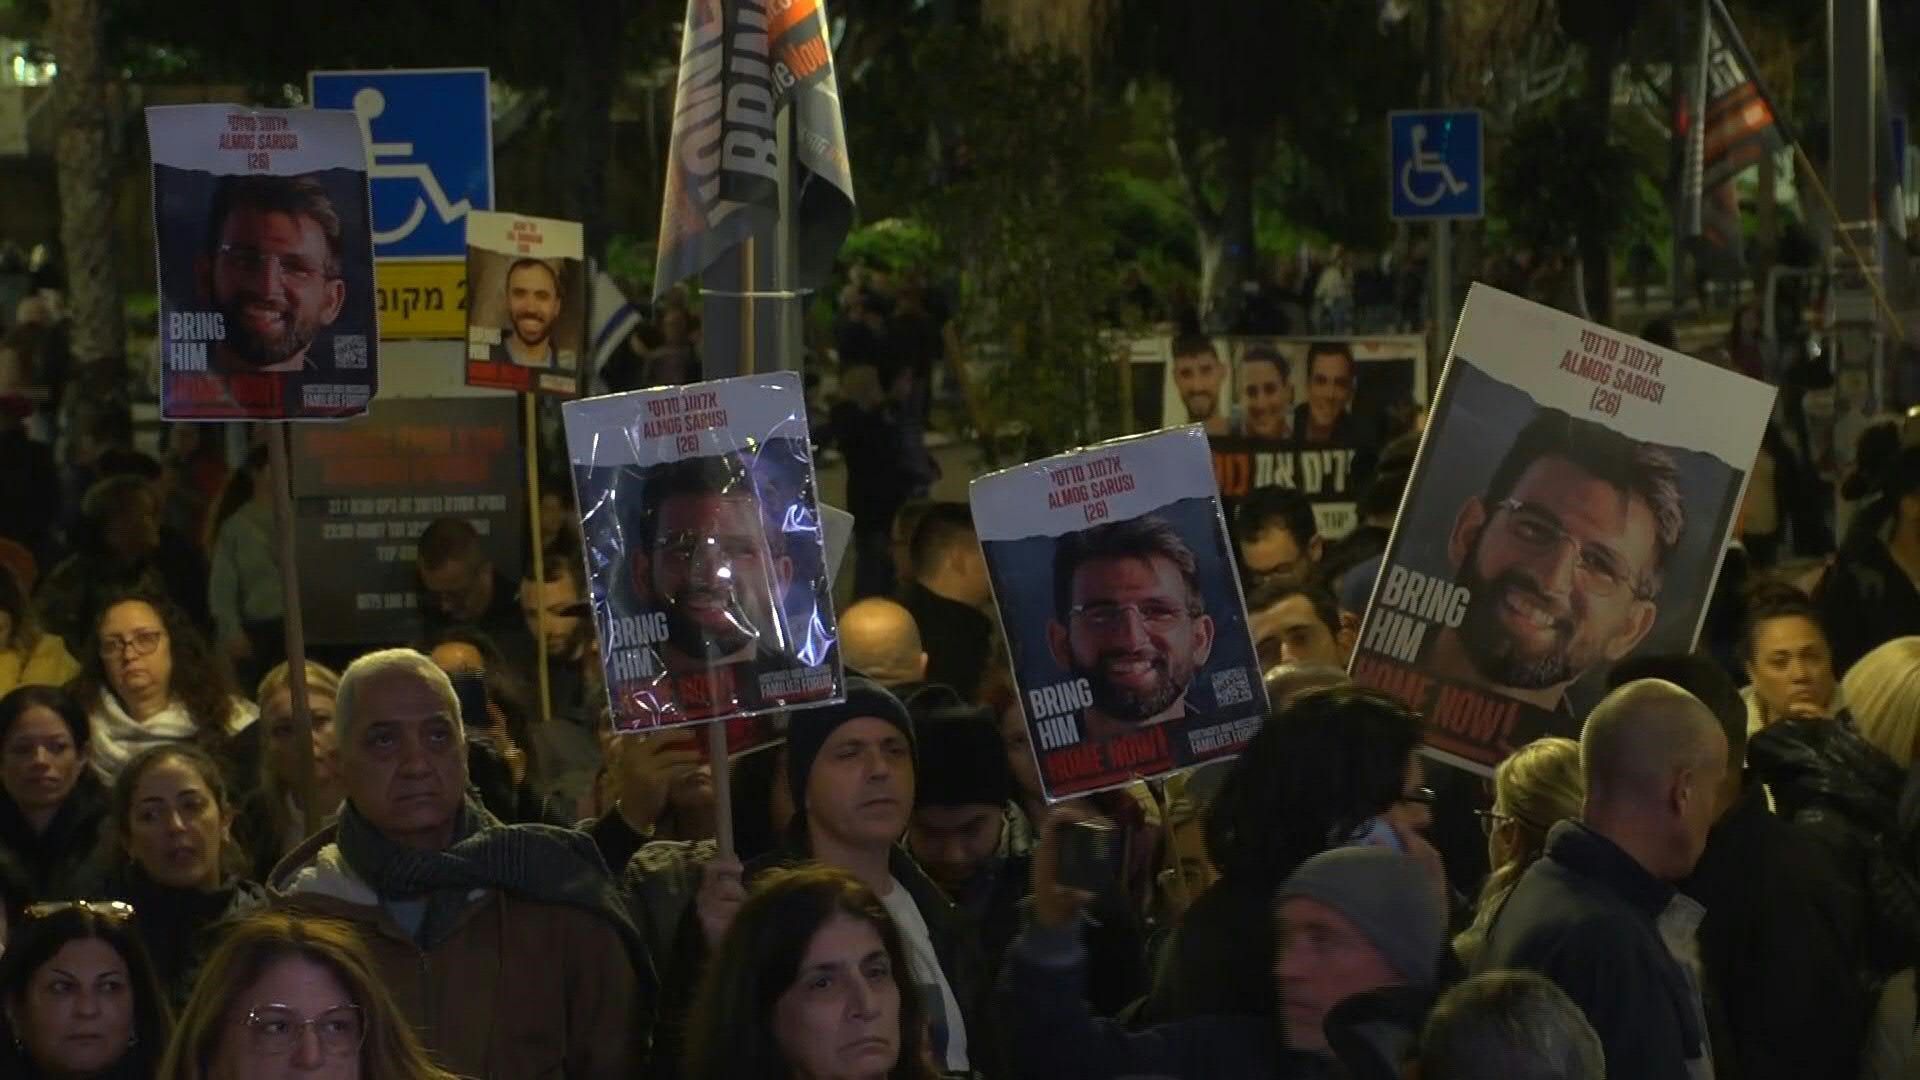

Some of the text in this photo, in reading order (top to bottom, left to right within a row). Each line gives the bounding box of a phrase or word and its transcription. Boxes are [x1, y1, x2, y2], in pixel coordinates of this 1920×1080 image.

[170, 311, 226, 341] BRING
[171, 342, 209, 372] HIM
[1580, 329, 1664, 378] אלמוג סרוסי
[1560, 349, 1666, 406] ALMOG SARUSI
[1590, 386, 1622, 418] (26)
[643, 409, 729, 440] ALMOG SARUSI
[676, 433, 700, 457] (26)
[1050, 456, 1124, 487] אלמוג סרוסי
[1253, 451, 1297, 490] את
[1048, 472, 1136, 510] ALMOG SARUSI
[1083, 499, 1109, 524] (26)
[1380, 564, 1471, 629] BRING
[611, 611, 671, 650] BRING
[1363, 606, 1428, 664] HIM
[613, 648, 652, 681] HIM
[1028, 676, 1094, 721] BRING
[1036, 713, 1081, 750] HIM
